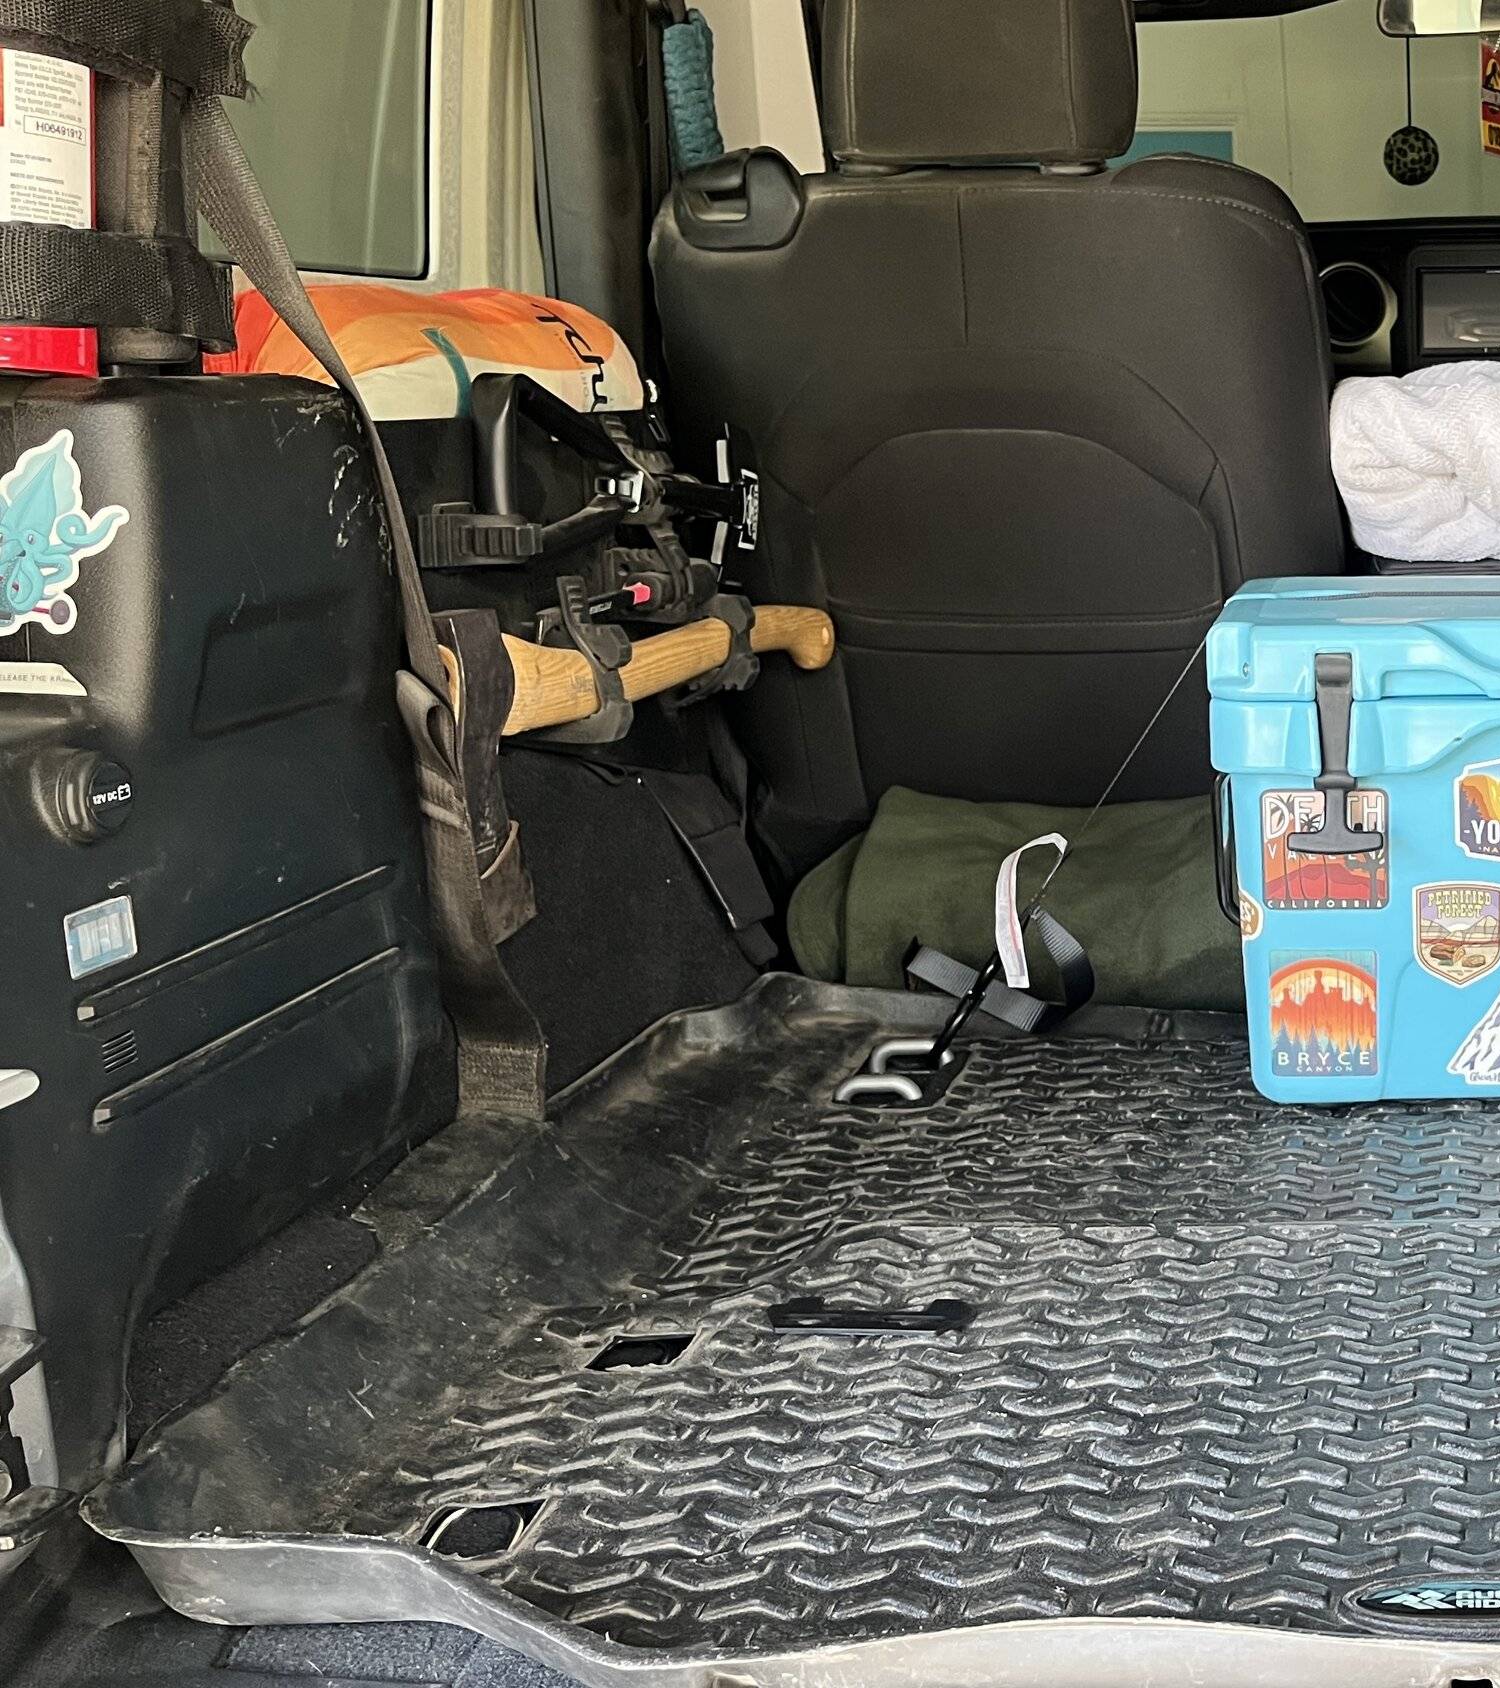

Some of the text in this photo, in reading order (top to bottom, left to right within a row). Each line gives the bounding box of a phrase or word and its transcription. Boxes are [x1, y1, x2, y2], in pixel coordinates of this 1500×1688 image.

[92, 790, 118, 806] 12V DC
[1263, 795, 1385, 842] DETH
[1427, 890, 1492, 907] PETRIFIED
[1437, 904, 1482, 918] FOREST
[1277, 1051, 1370, 1066] BRYCE
